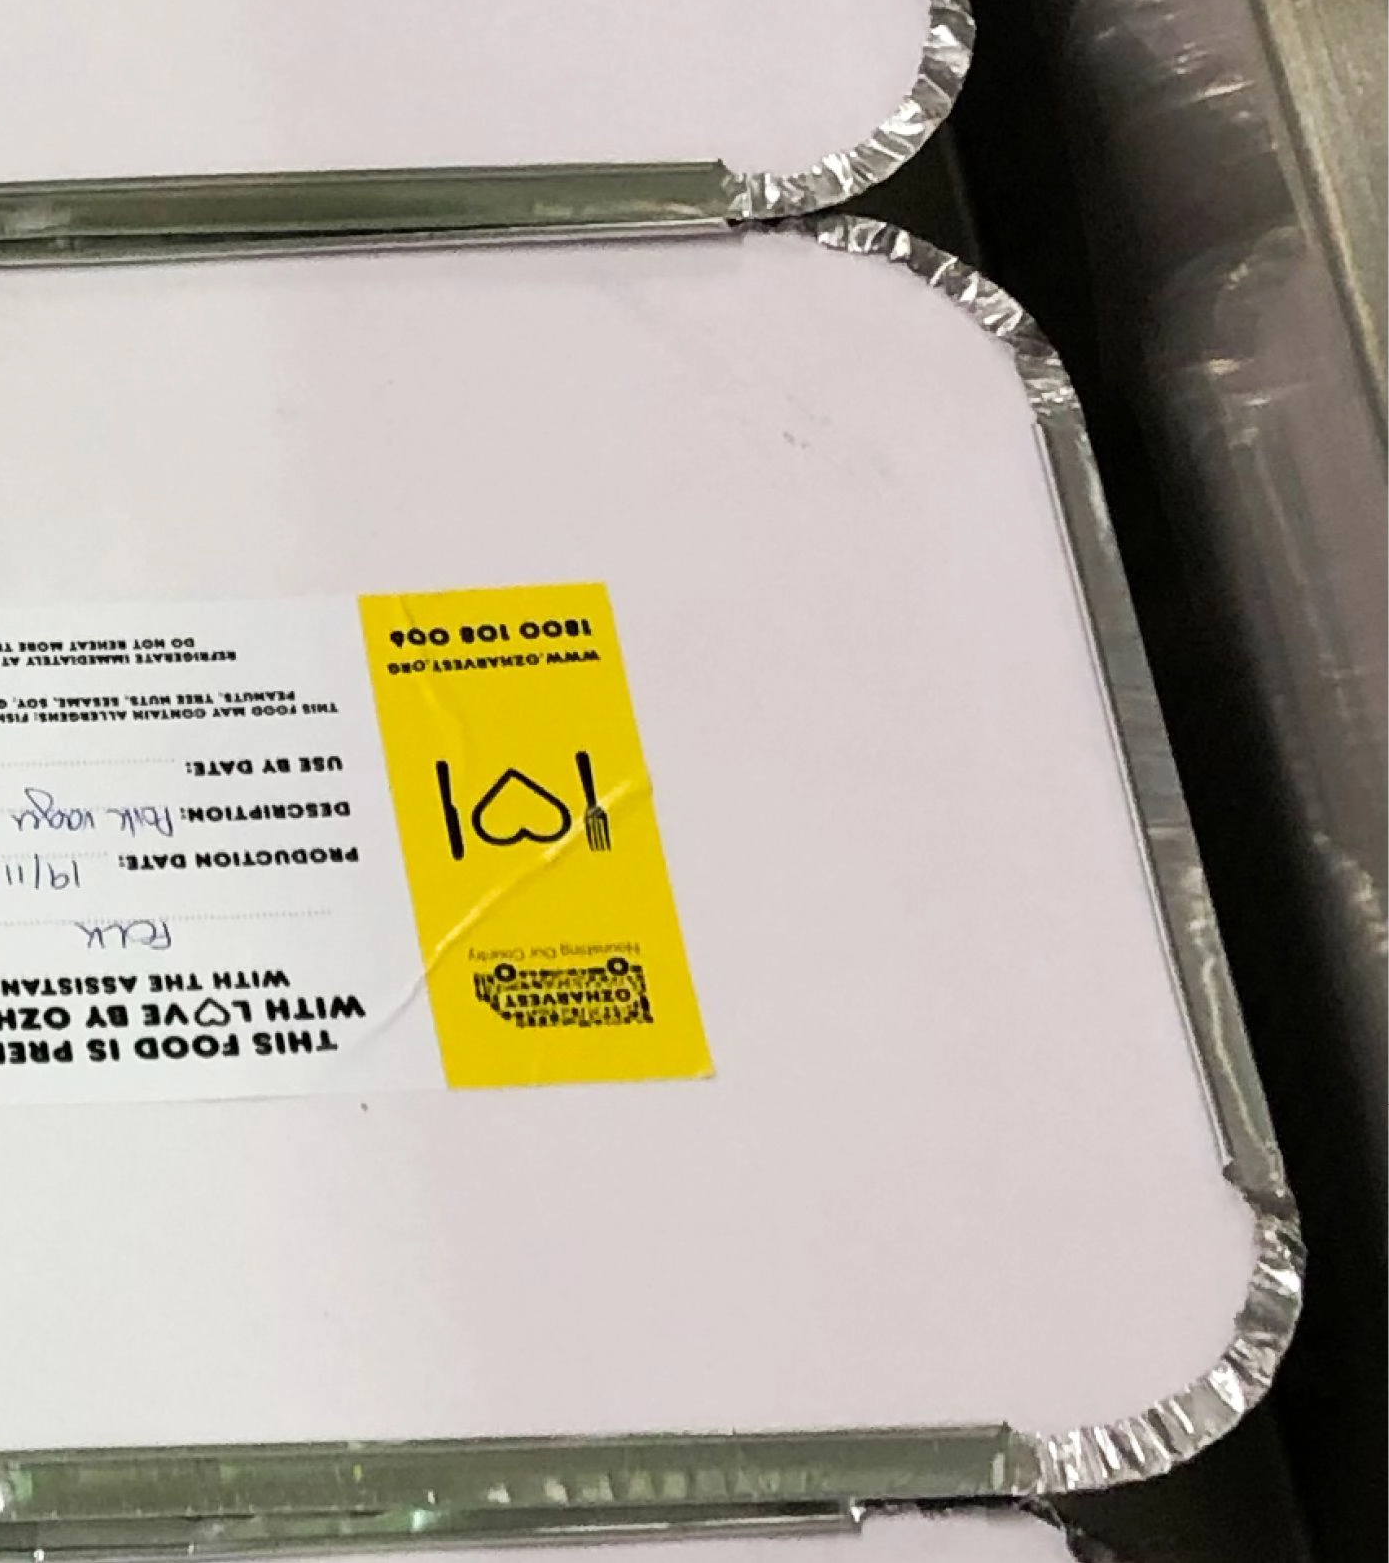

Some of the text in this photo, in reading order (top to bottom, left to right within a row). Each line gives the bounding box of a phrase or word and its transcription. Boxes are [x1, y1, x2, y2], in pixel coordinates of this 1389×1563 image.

[390, 619, 591, 648] 1800 108 006
[387, 650, 600, 675] WWW.OZHARVEST.ORG
[186, 756, 343, 776] USE BY DATE:
[180, 801, 350, 822] DESCRIPTION:
[119, 854, 186, 870] DATE:
[195, 847, 359, 868] PRODUCTION
[148, 973, 203, 992] THE
[213, 970, 290, 989] WITH
[86, 1005, 129, 1028] BY
[265, 995, 366, 1022] WITH
[86, 1039, 120, 1062] IS
[134, 1033, 239, 1059] FOOD
[252, 1030, 338, 1055] THIS
